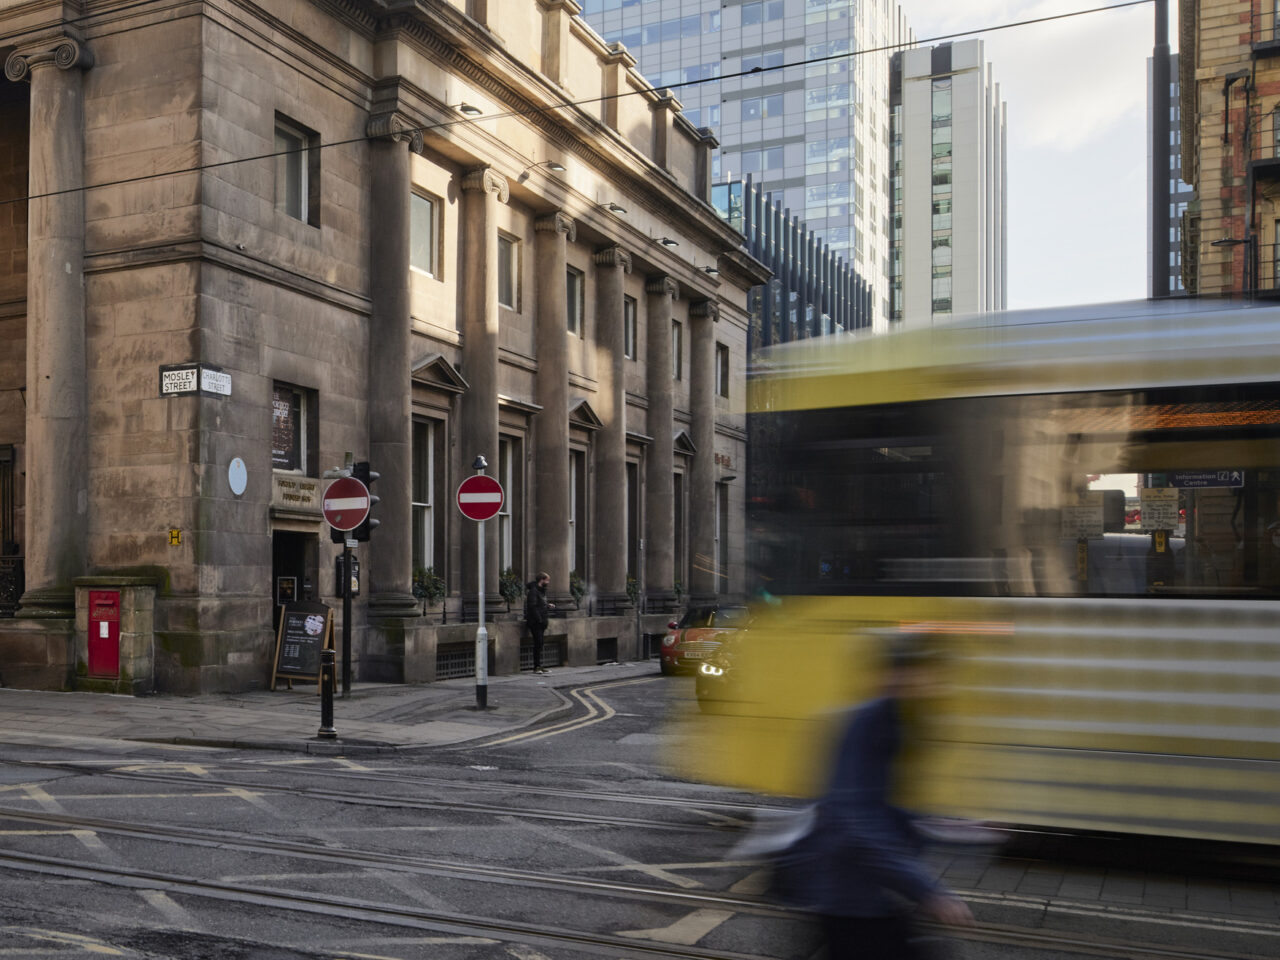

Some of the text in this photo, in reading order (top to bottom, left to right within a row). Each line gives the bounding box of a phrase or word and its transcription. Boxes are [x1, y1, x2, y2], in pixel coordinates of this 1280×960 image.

[163, 370, 195, 382] MOSLEY
[164, 381, 192, 392] STREET
[208, 381, 225, 392] STREET
